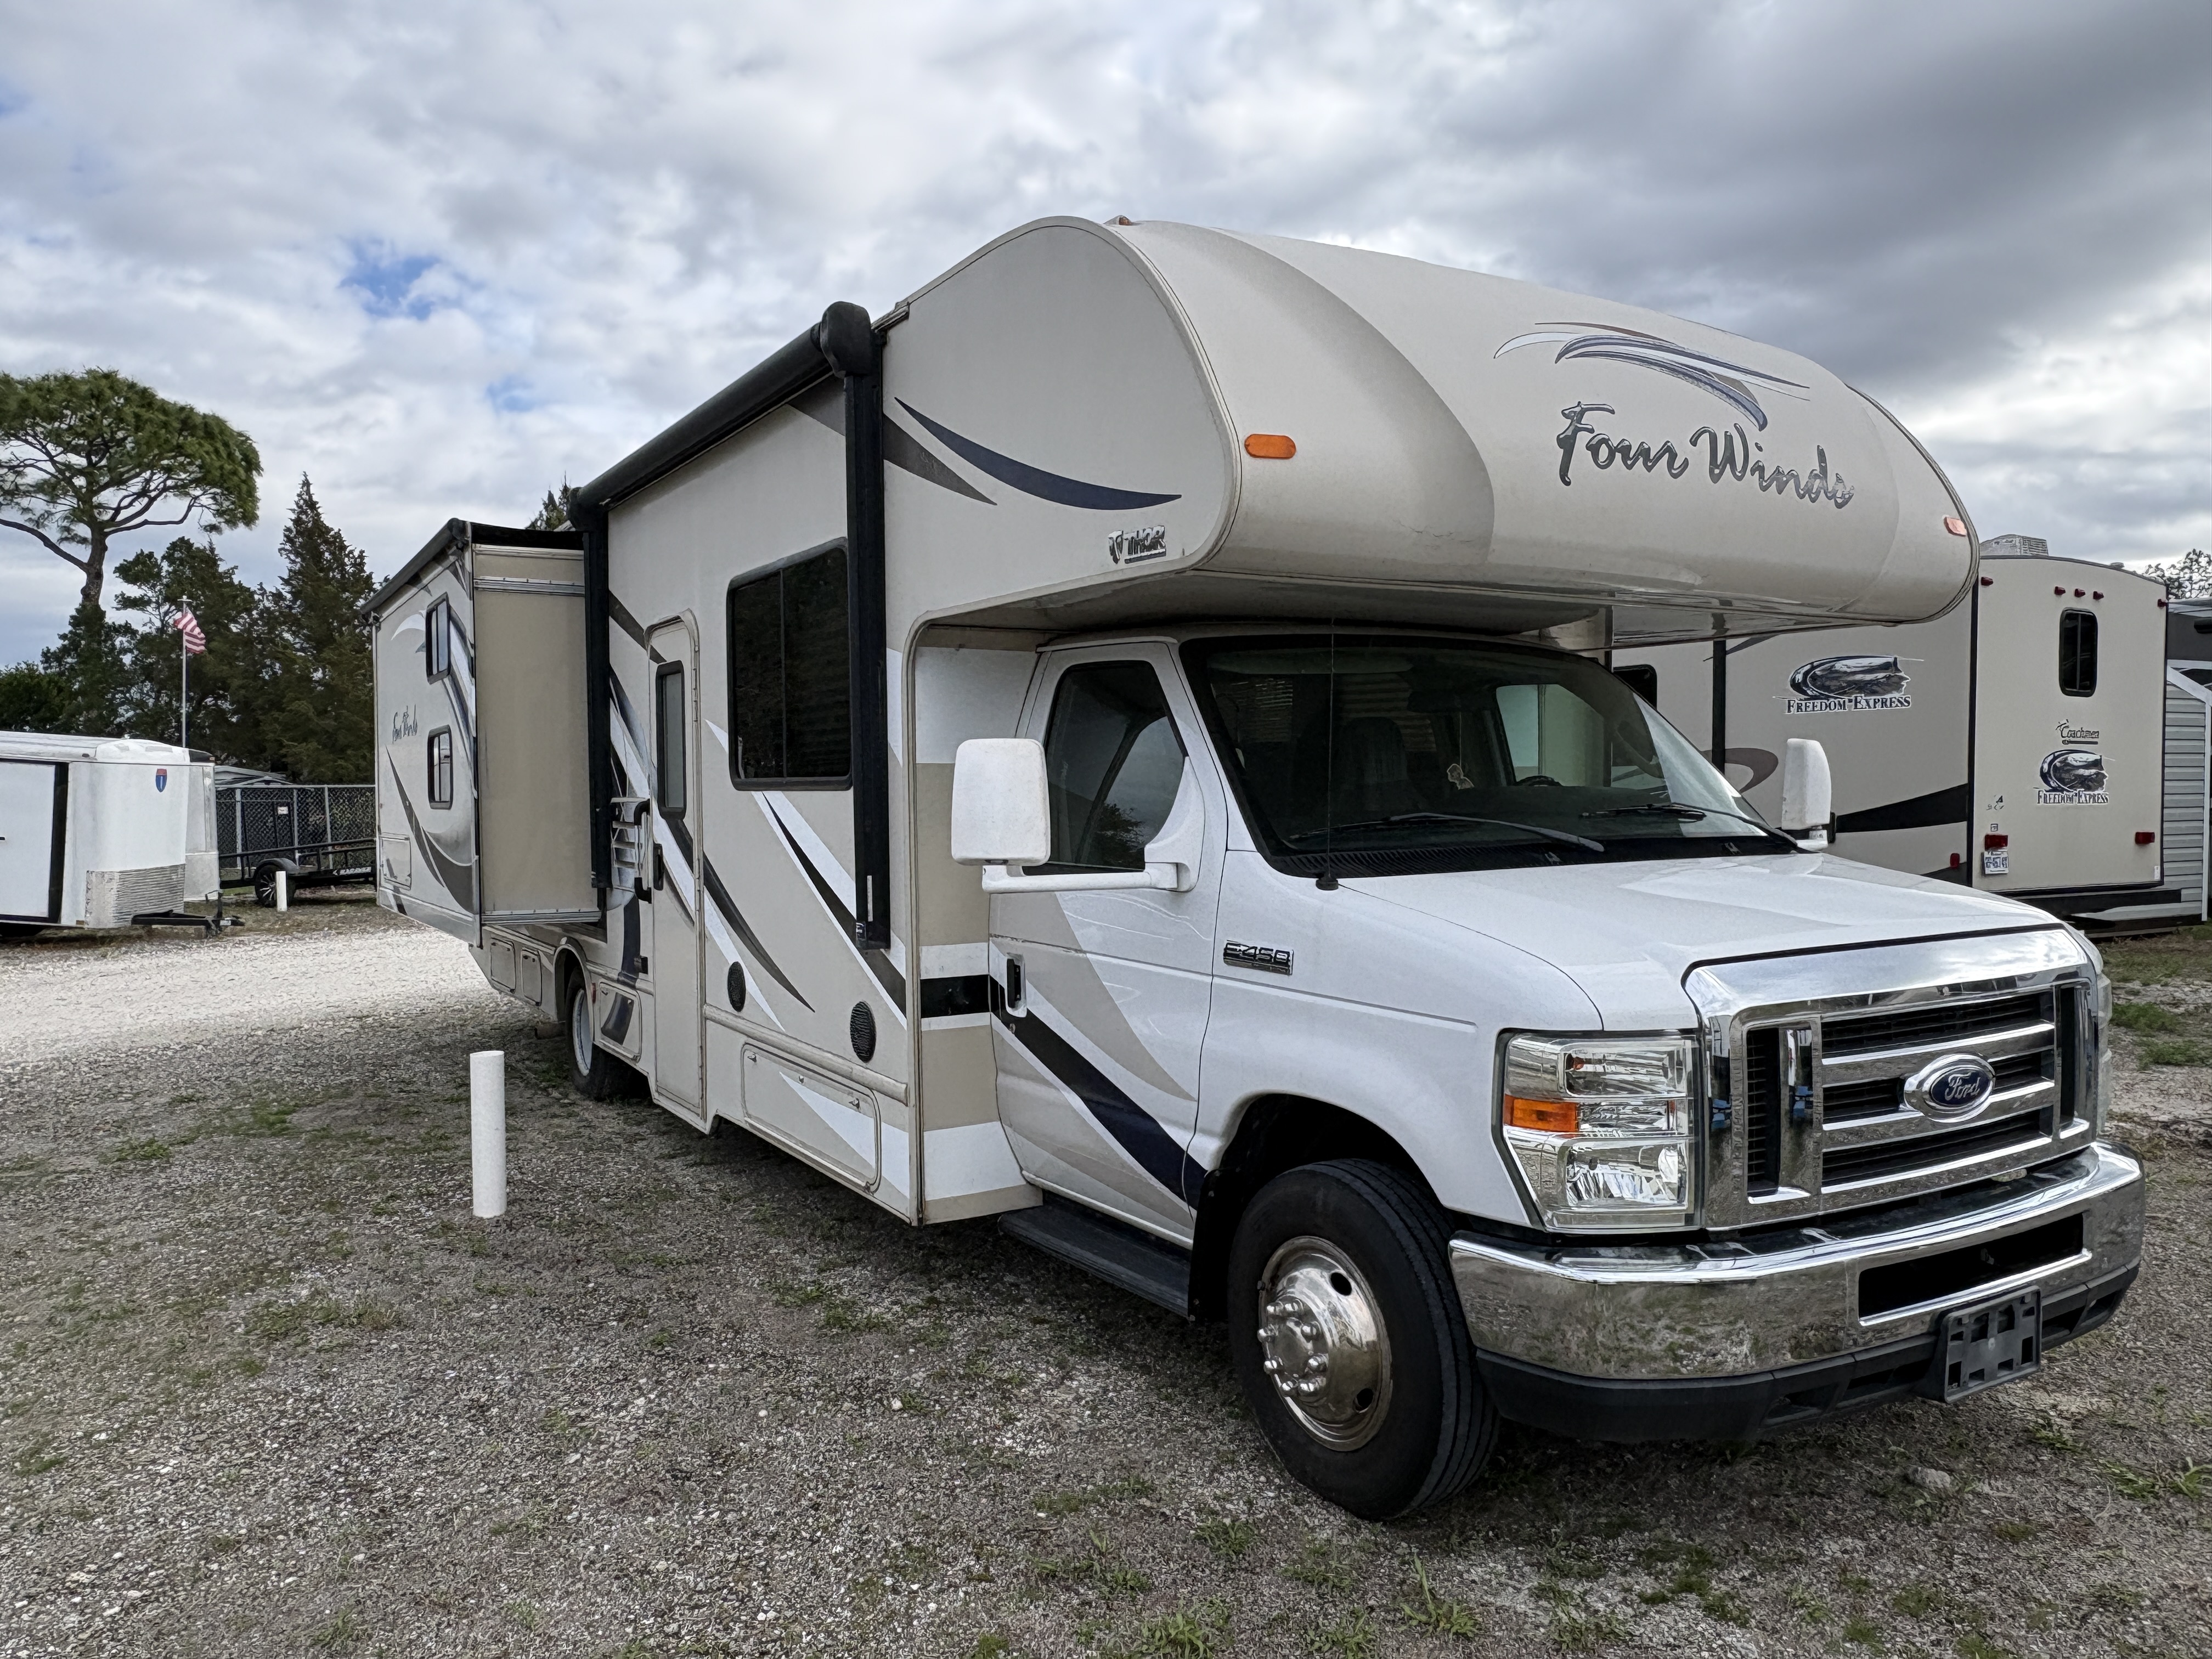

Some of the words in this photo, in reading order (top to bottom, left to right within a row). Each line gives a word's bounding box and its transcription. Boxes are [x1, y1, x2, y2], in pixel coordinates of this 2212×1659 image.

[1556, 400, 1689, 486] Four
[1690, 423, 1855, 509] Winds
[1945, 1071, 1981, 1101] Ford
